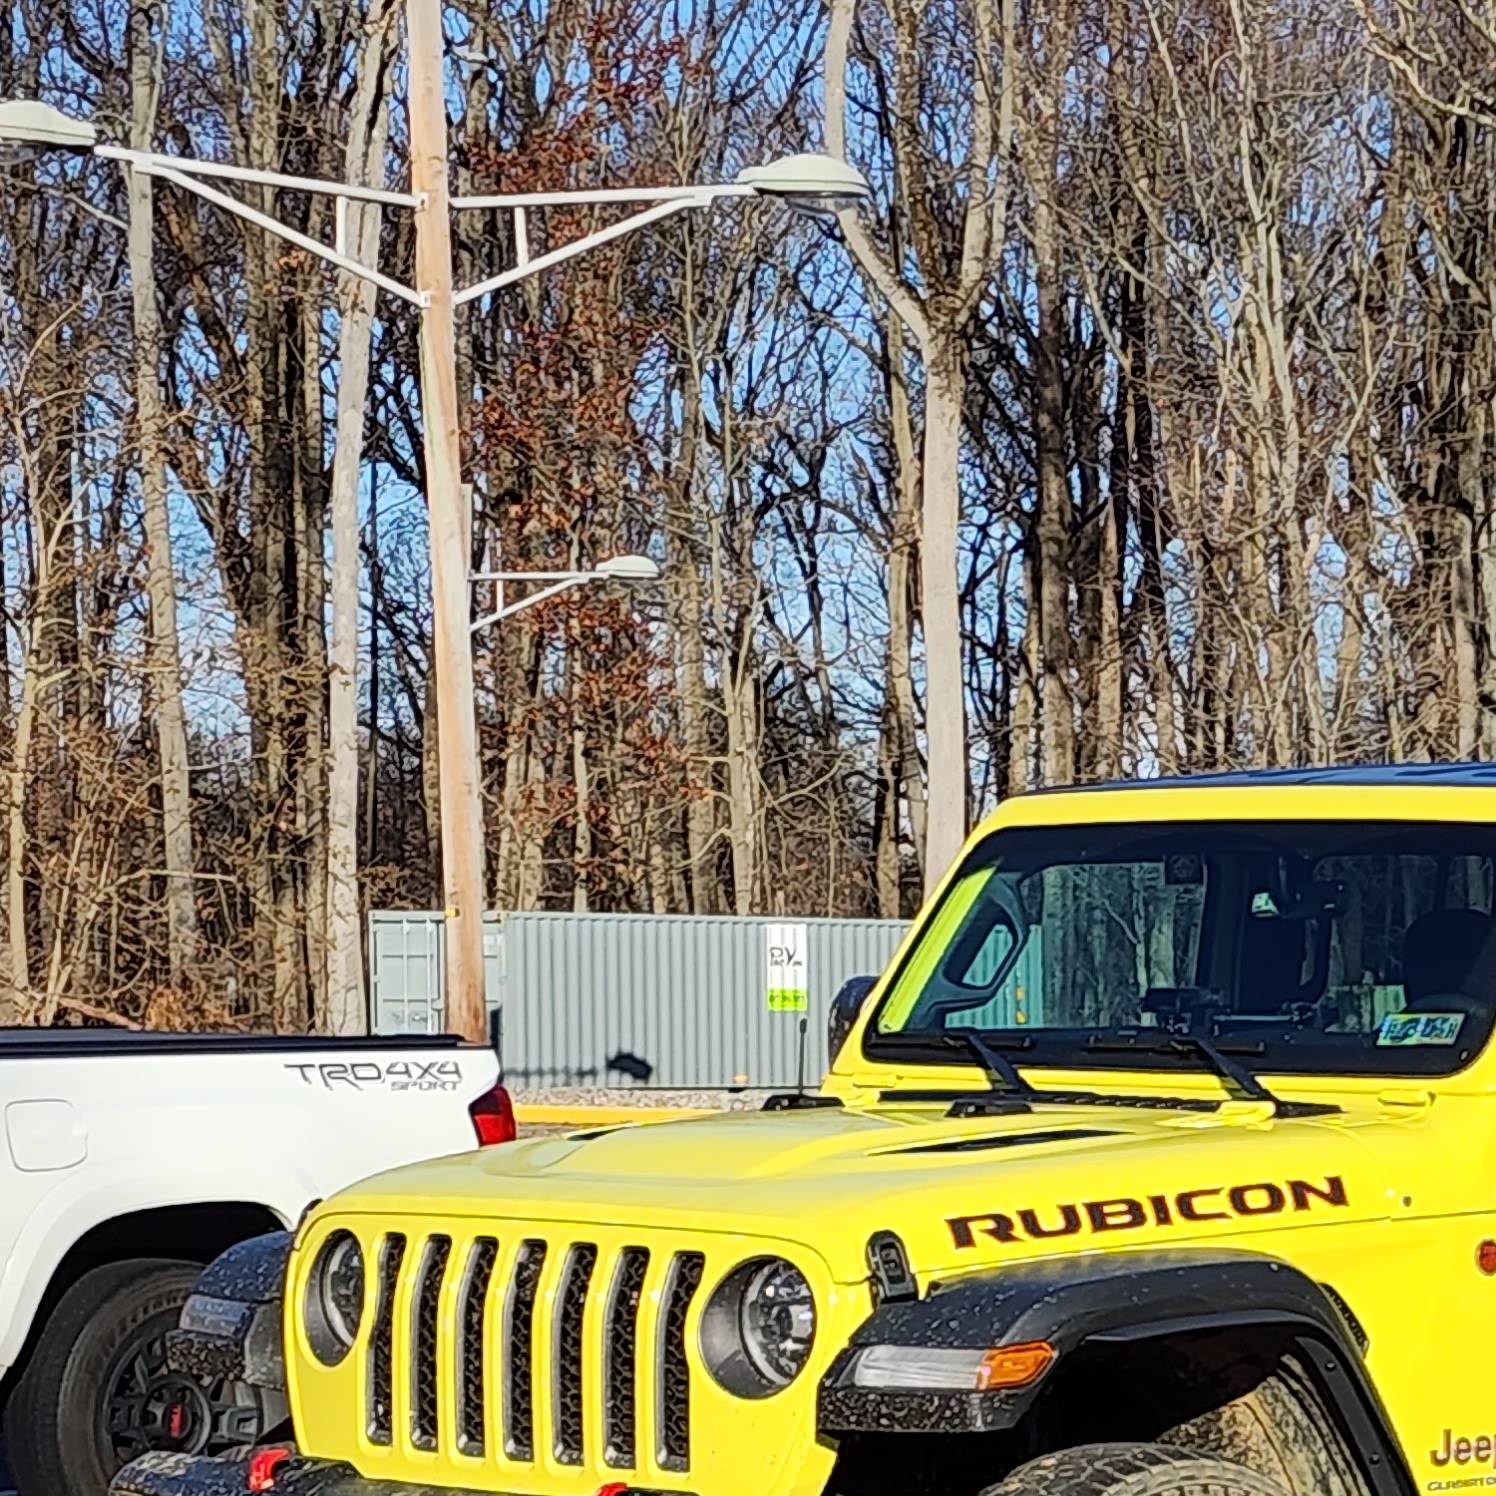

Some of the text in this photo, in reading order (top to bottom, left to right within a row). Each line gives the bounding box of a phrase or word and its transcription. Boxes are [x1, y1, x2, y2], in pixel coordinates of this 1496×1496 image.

[283, 1062, 384, 1091] TRD
[390, 1080, 462, 1091] SPORT
[944, 1175, 1350, 1249] RUBICON
